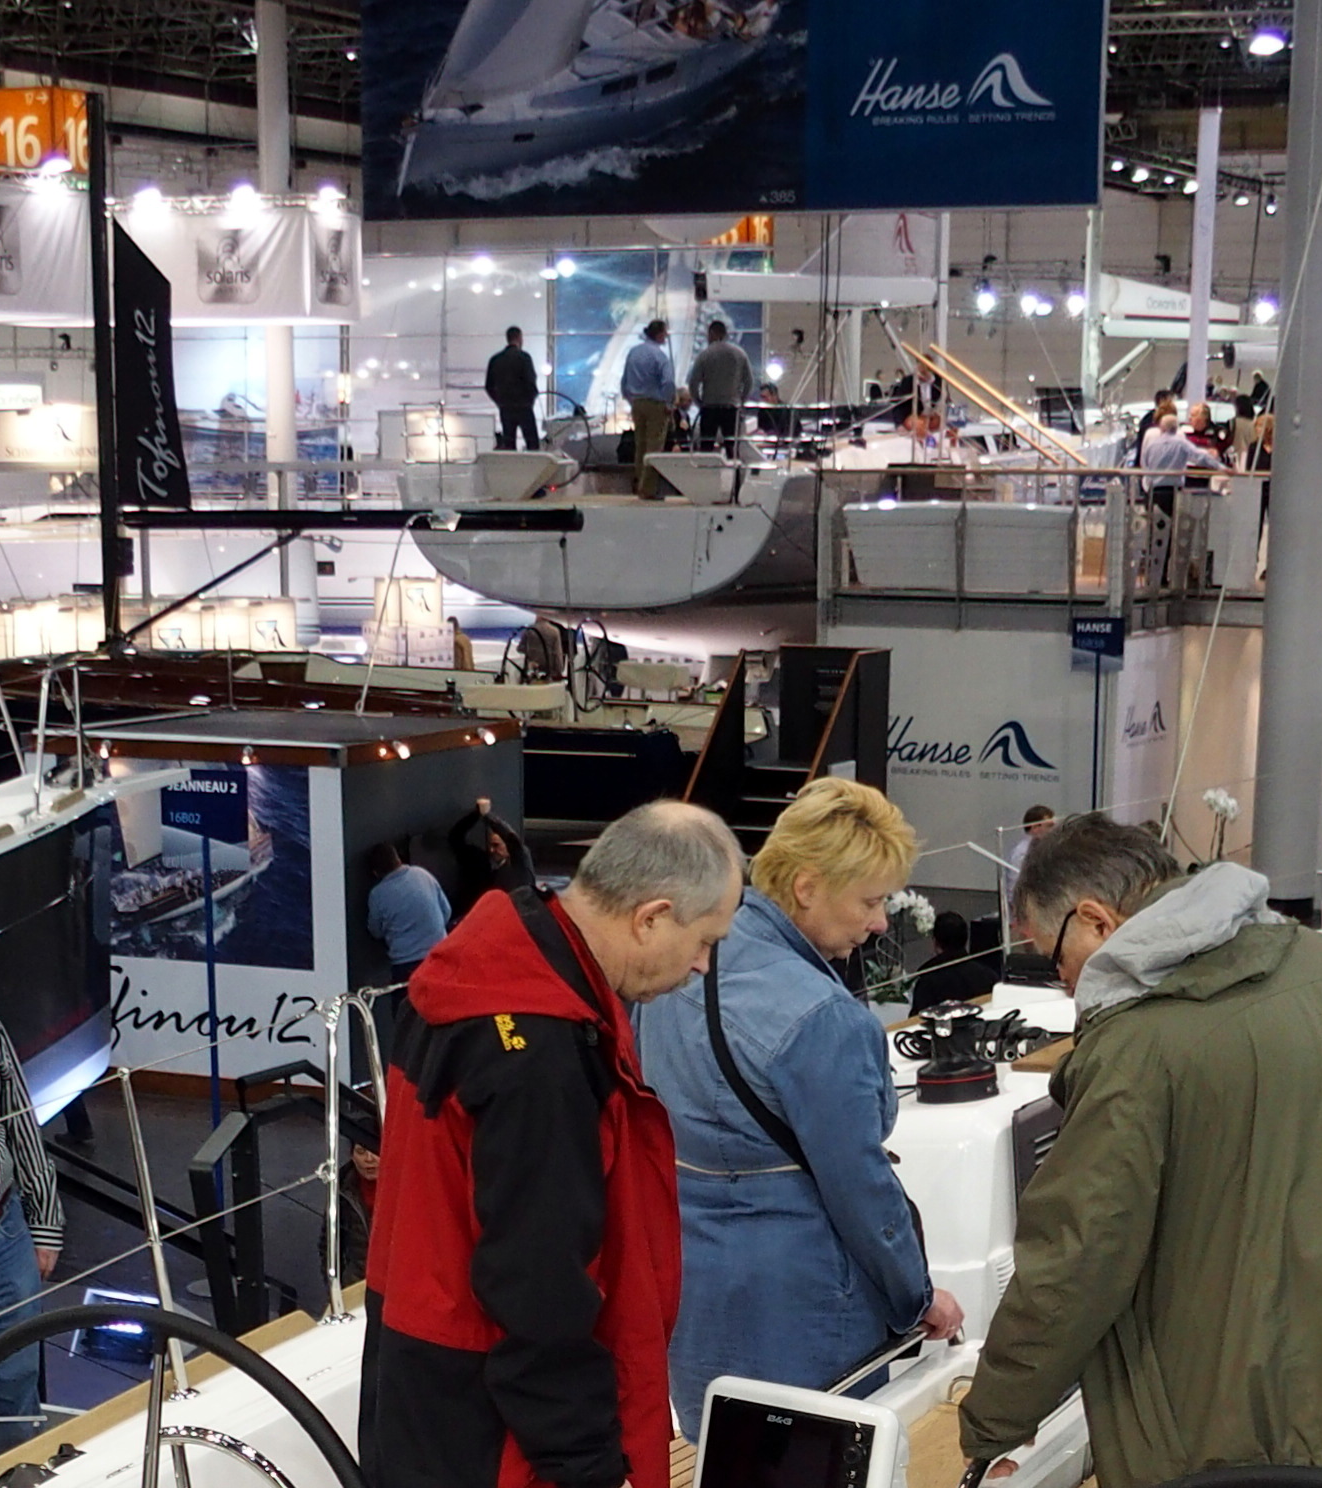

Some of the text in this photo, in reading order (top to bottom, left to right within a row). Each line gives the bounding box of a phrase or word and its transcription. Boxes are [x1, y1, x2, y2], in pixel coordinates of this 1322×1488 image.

[850, 58, 961, 117] Hanse
[1015, 111, 1056, 121] TRENDS
[1076, 622, 1113, 633] HANSE
[886, 716, 972, 765] Hanse
[890, 767, 938, 777] BREAKING
[940, 769, 971, 778] RULES
[167, 780, 238, 794] JEANNEAU 2
